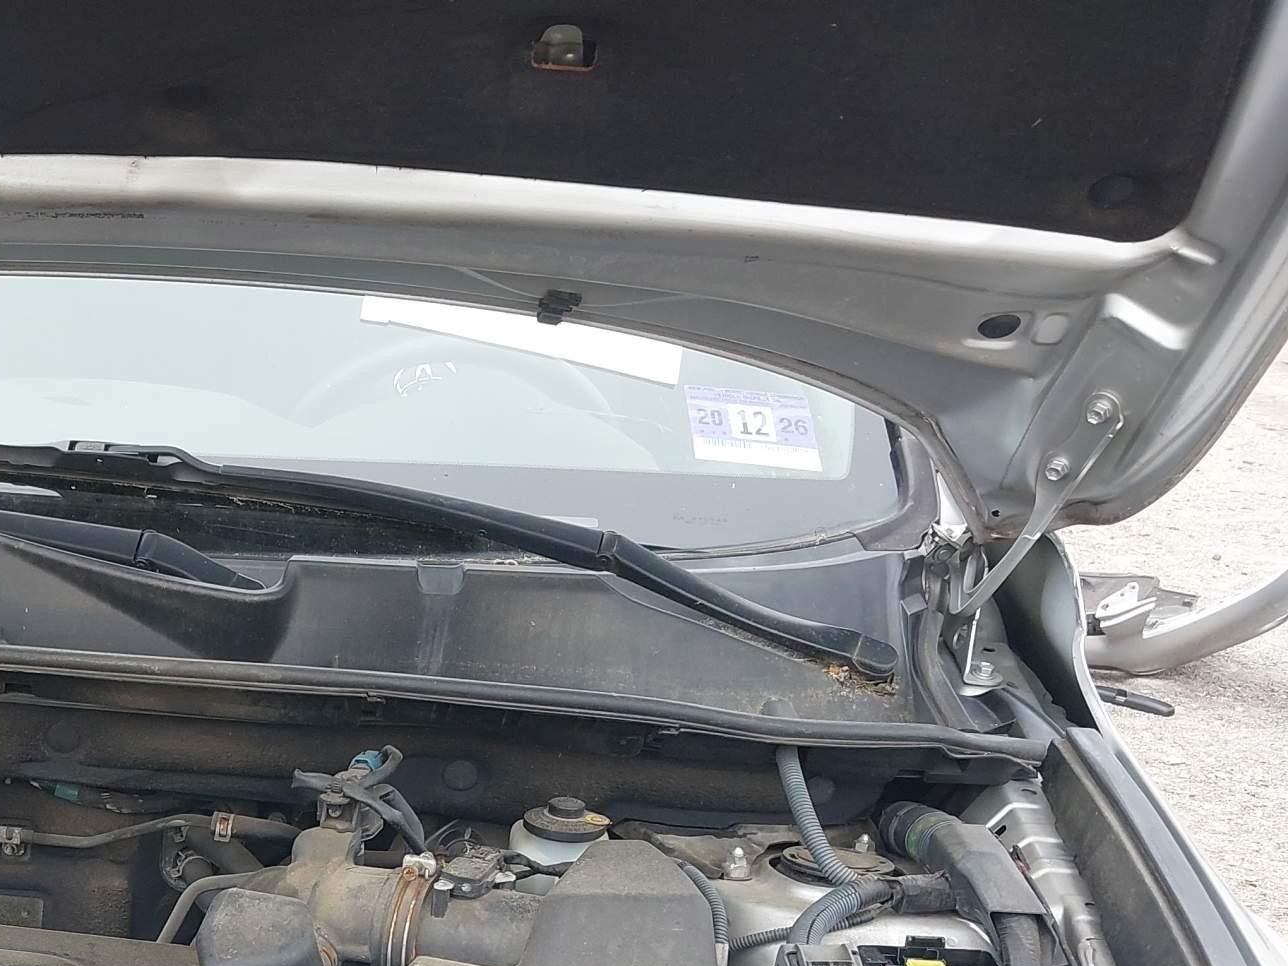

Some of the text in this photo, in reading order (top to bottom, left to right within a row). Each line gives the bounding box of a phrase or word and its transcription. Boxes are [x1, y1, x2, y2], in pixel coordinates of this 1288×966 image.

[696, 408, 809, 437] 20 12 26
